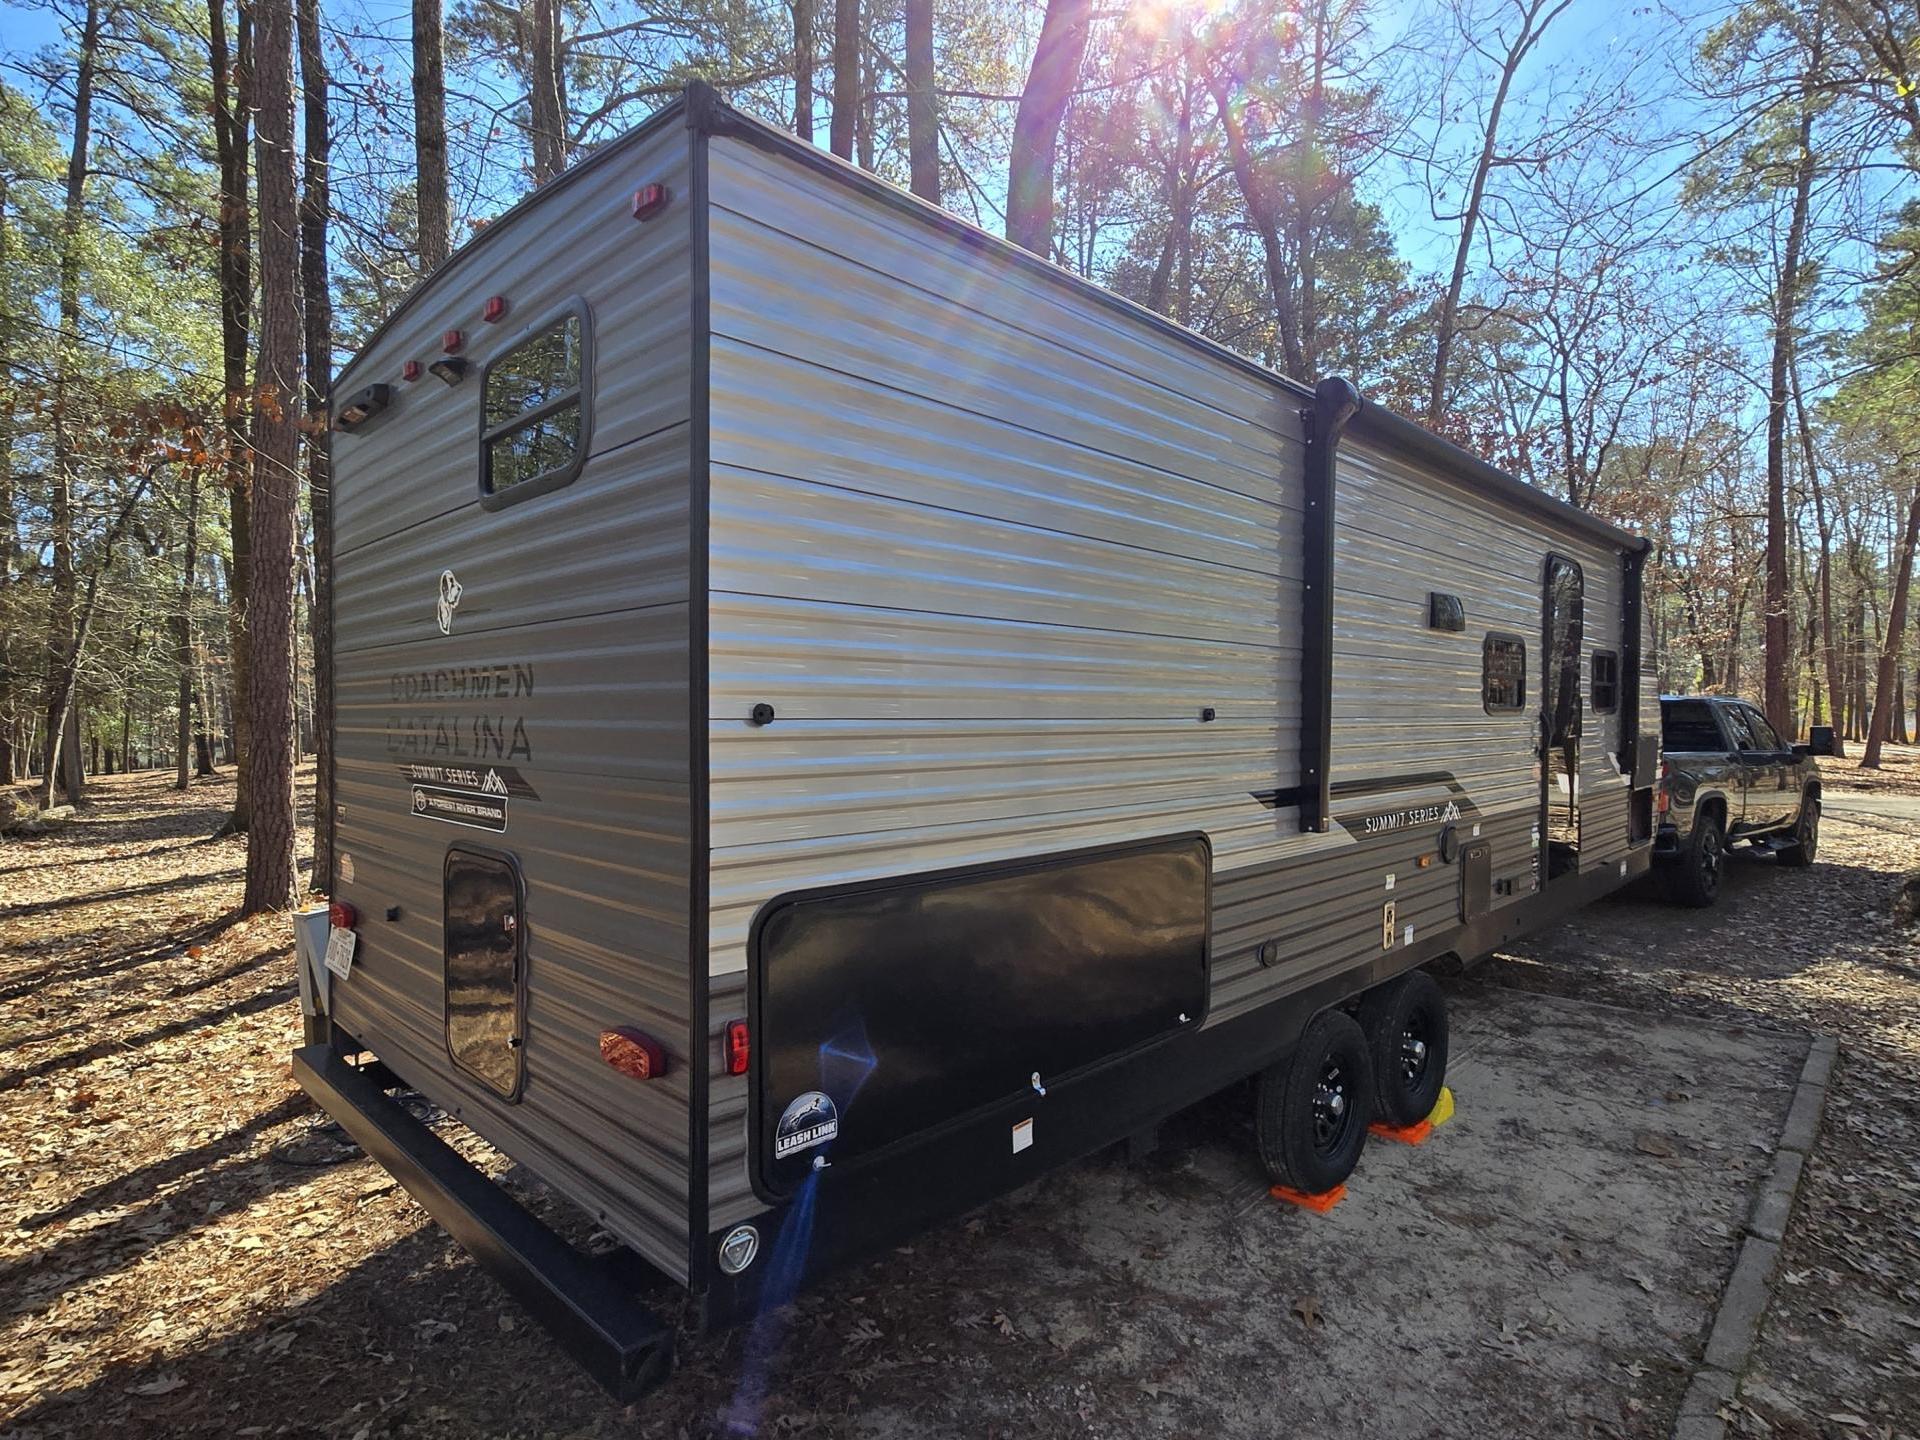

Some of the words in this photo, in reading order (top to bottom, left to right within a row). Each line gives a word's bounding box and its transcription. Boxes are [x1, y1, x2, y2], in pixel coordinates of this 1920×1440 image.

[391, 663, 535, 701] COACHMEN
[386, 714, 531, 762] CATALINA
[411, 764, 442, 781] SUMMIT
[446, 768, 479, 786] SERIES
[477, 805, 502, 818] BRAND
[1365, 812, 1405, 833] SUMMIT
[1409, 806, 1439, 825] SERIES
[777, 1128, 812, 1152] LEASH
[812, 1121, 836, 1140] LINK
